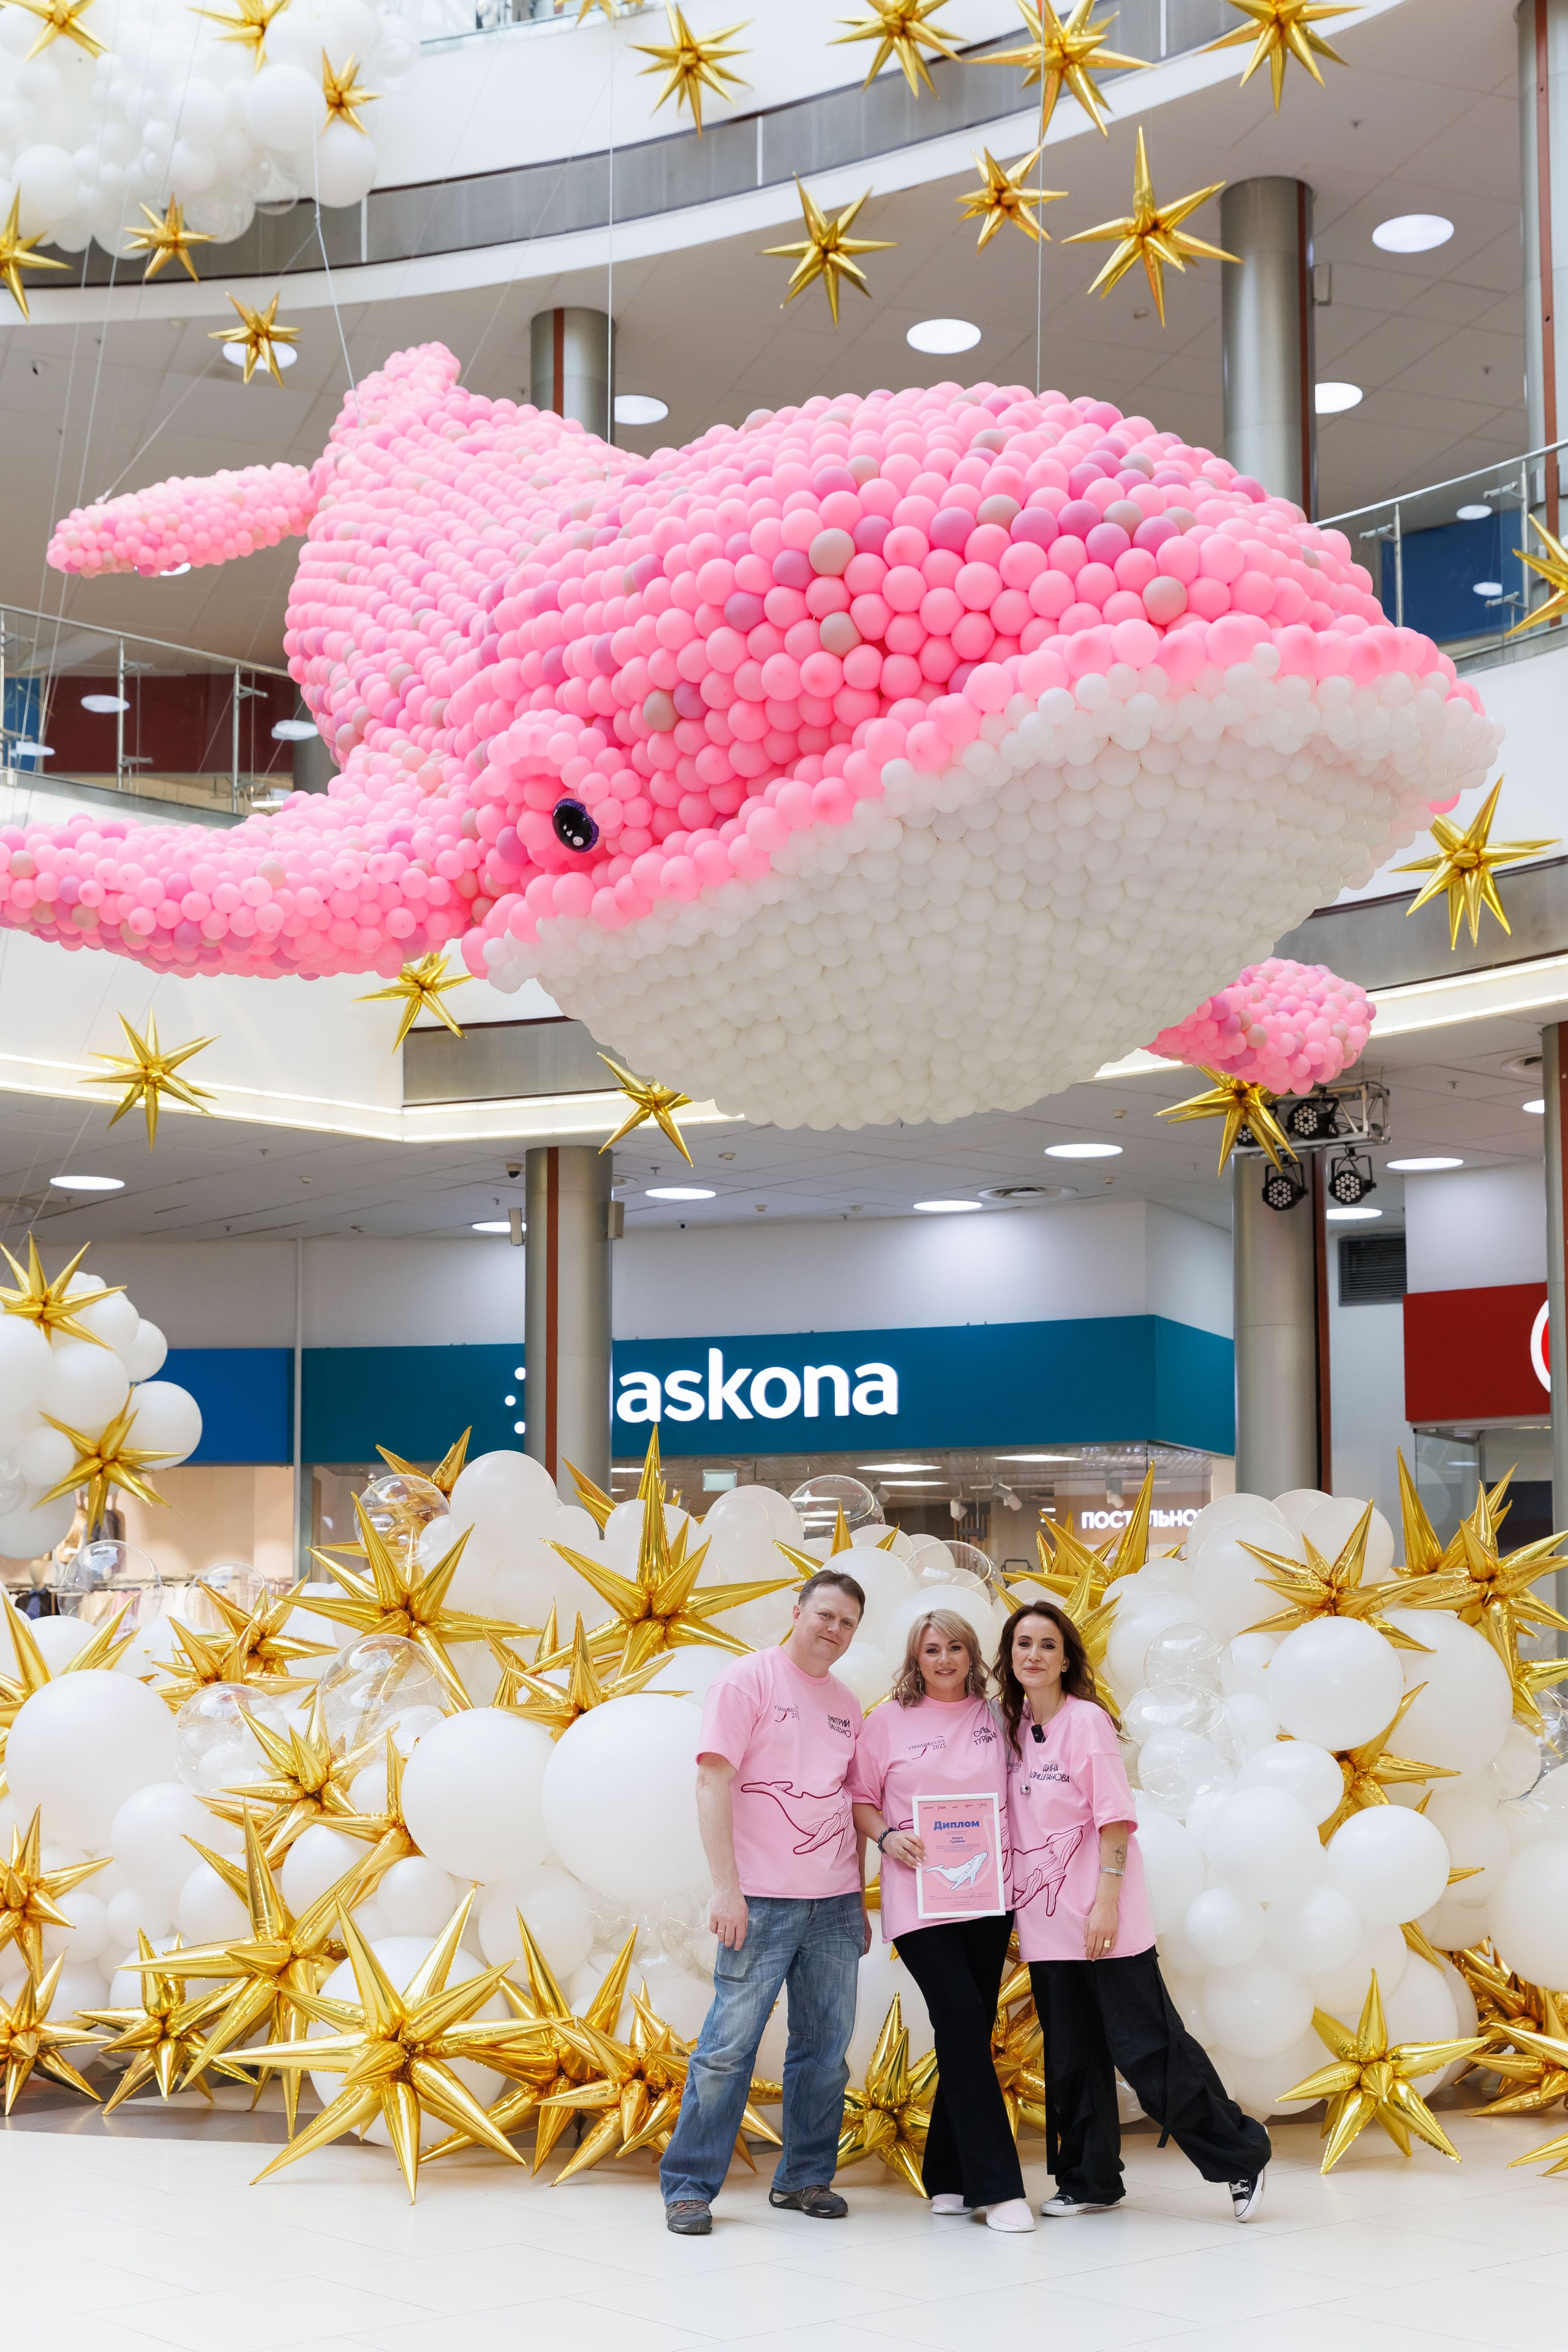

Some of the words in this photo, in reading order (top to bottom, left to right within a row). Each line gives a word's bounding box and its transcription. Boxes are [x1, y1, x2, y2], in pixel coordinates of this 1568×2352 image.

[617, 1348, 899, 1423] askona
[1081, 1509, 1202, 1529] ПОСТЛЬНО
[973, 1727, 991, 1737] ОЛЬА
[1042, 1763, 1059, 1772] ДИНА
[933, 1820, 980, 1831] Диплом
